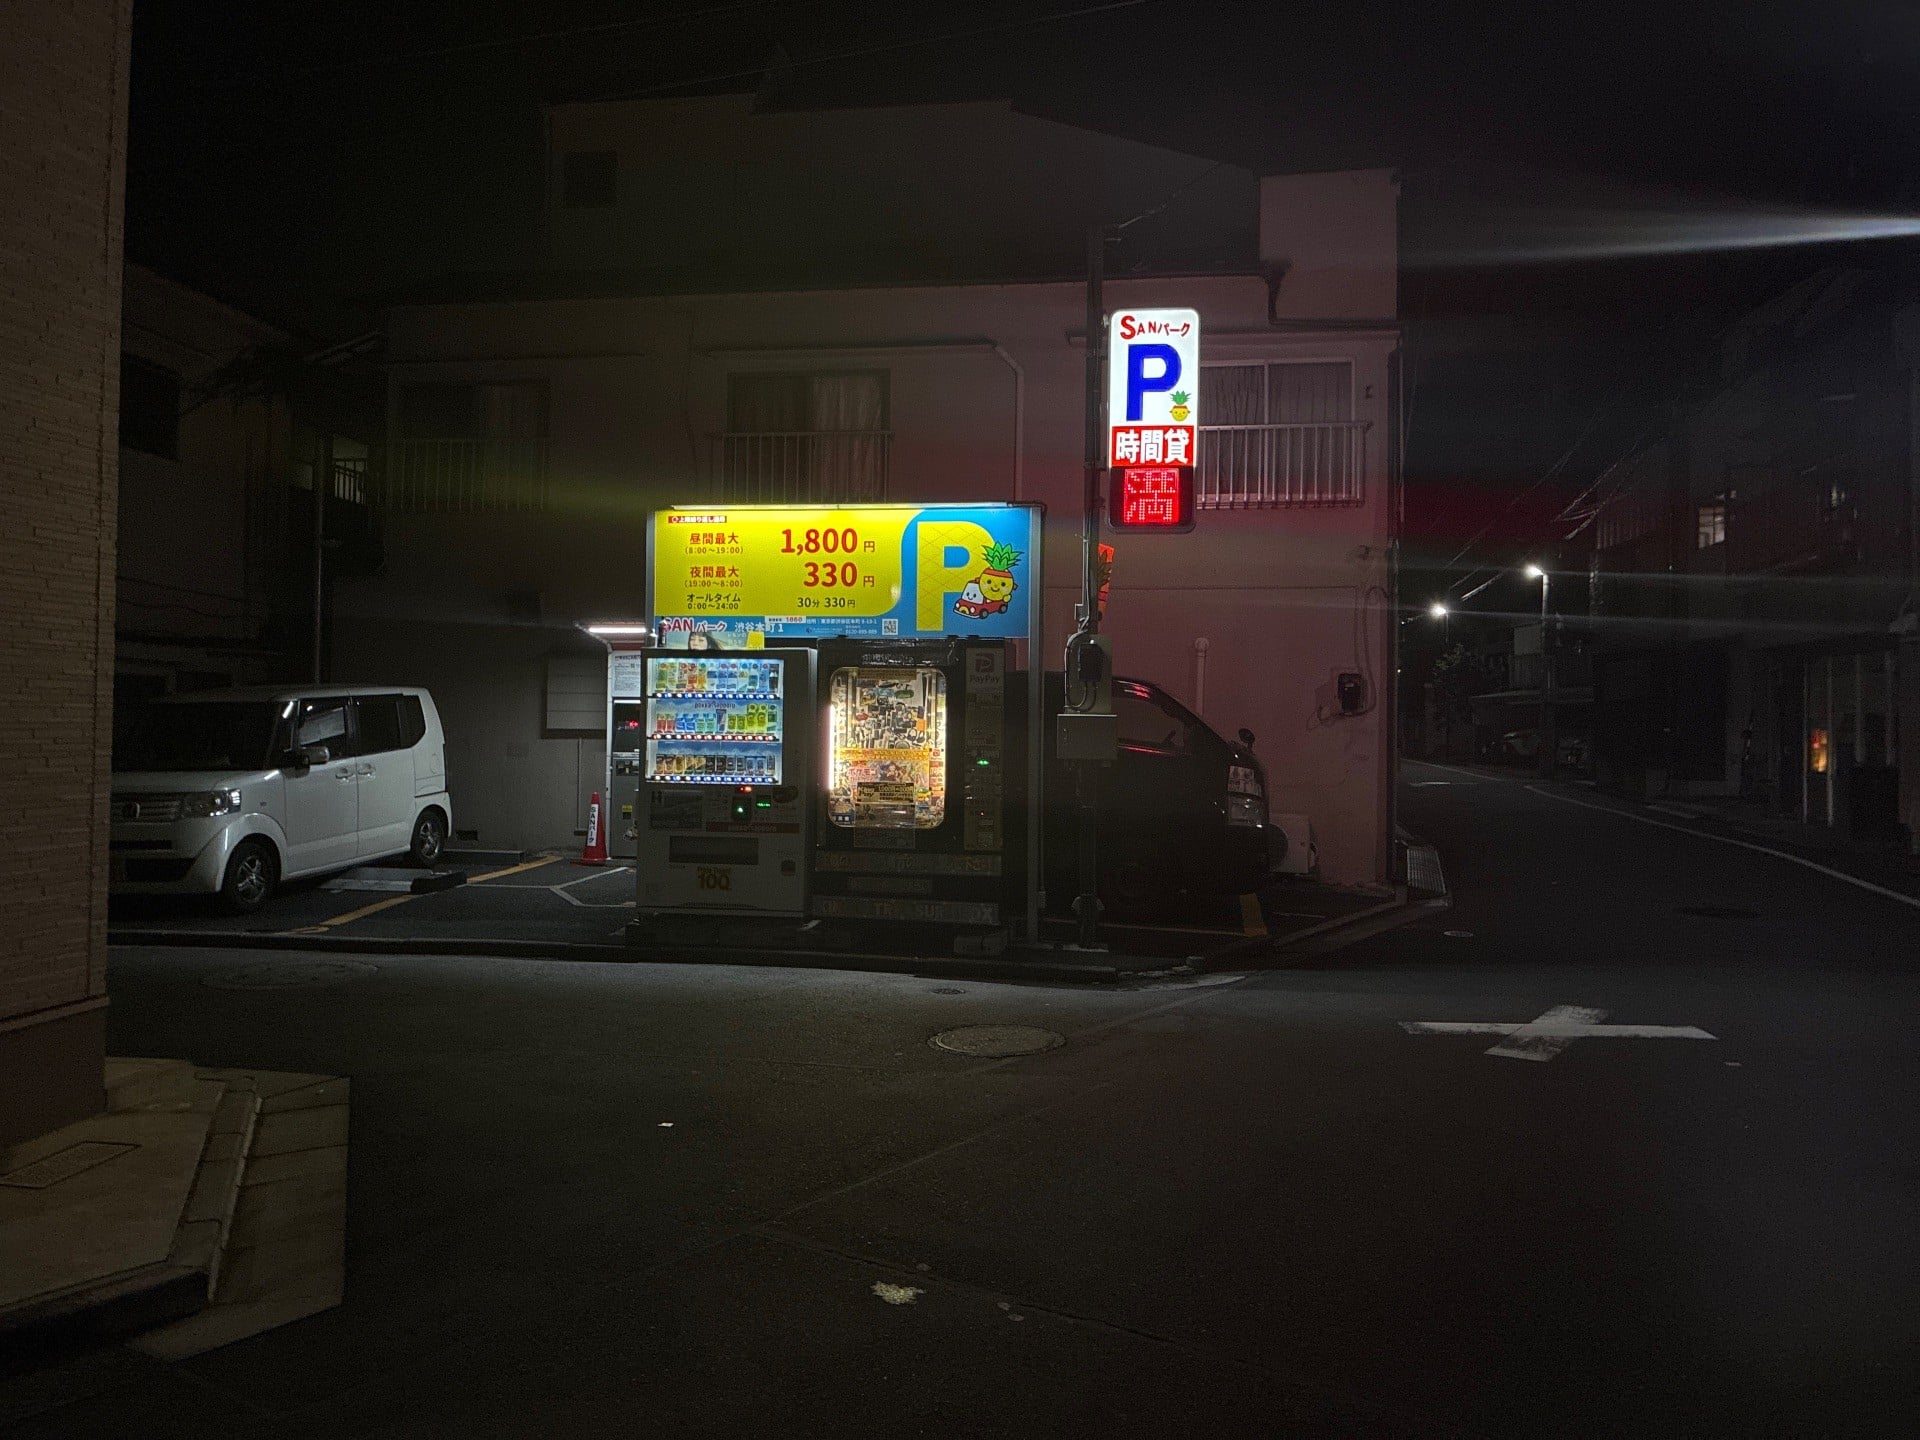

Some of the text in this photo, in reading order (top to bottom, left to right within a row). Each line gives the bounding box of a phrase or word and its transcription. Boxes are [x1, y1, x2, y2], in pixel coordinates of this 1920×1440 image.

[1120, 315, 1191, 340] SANパーク
[1126, 344, 1182, 421] P
[1115, 428, 1190, 465] 時間貸
[1127, 471, 1177, 521] 満
[689, 532, 740, 545] 昼間最大
[689, 566, 740, 578] 夜間最大
[916, 521, 995, 631] P
[686, 593, 741, 603] オールタイム
[969, 674, 1000, 684] PayPay
